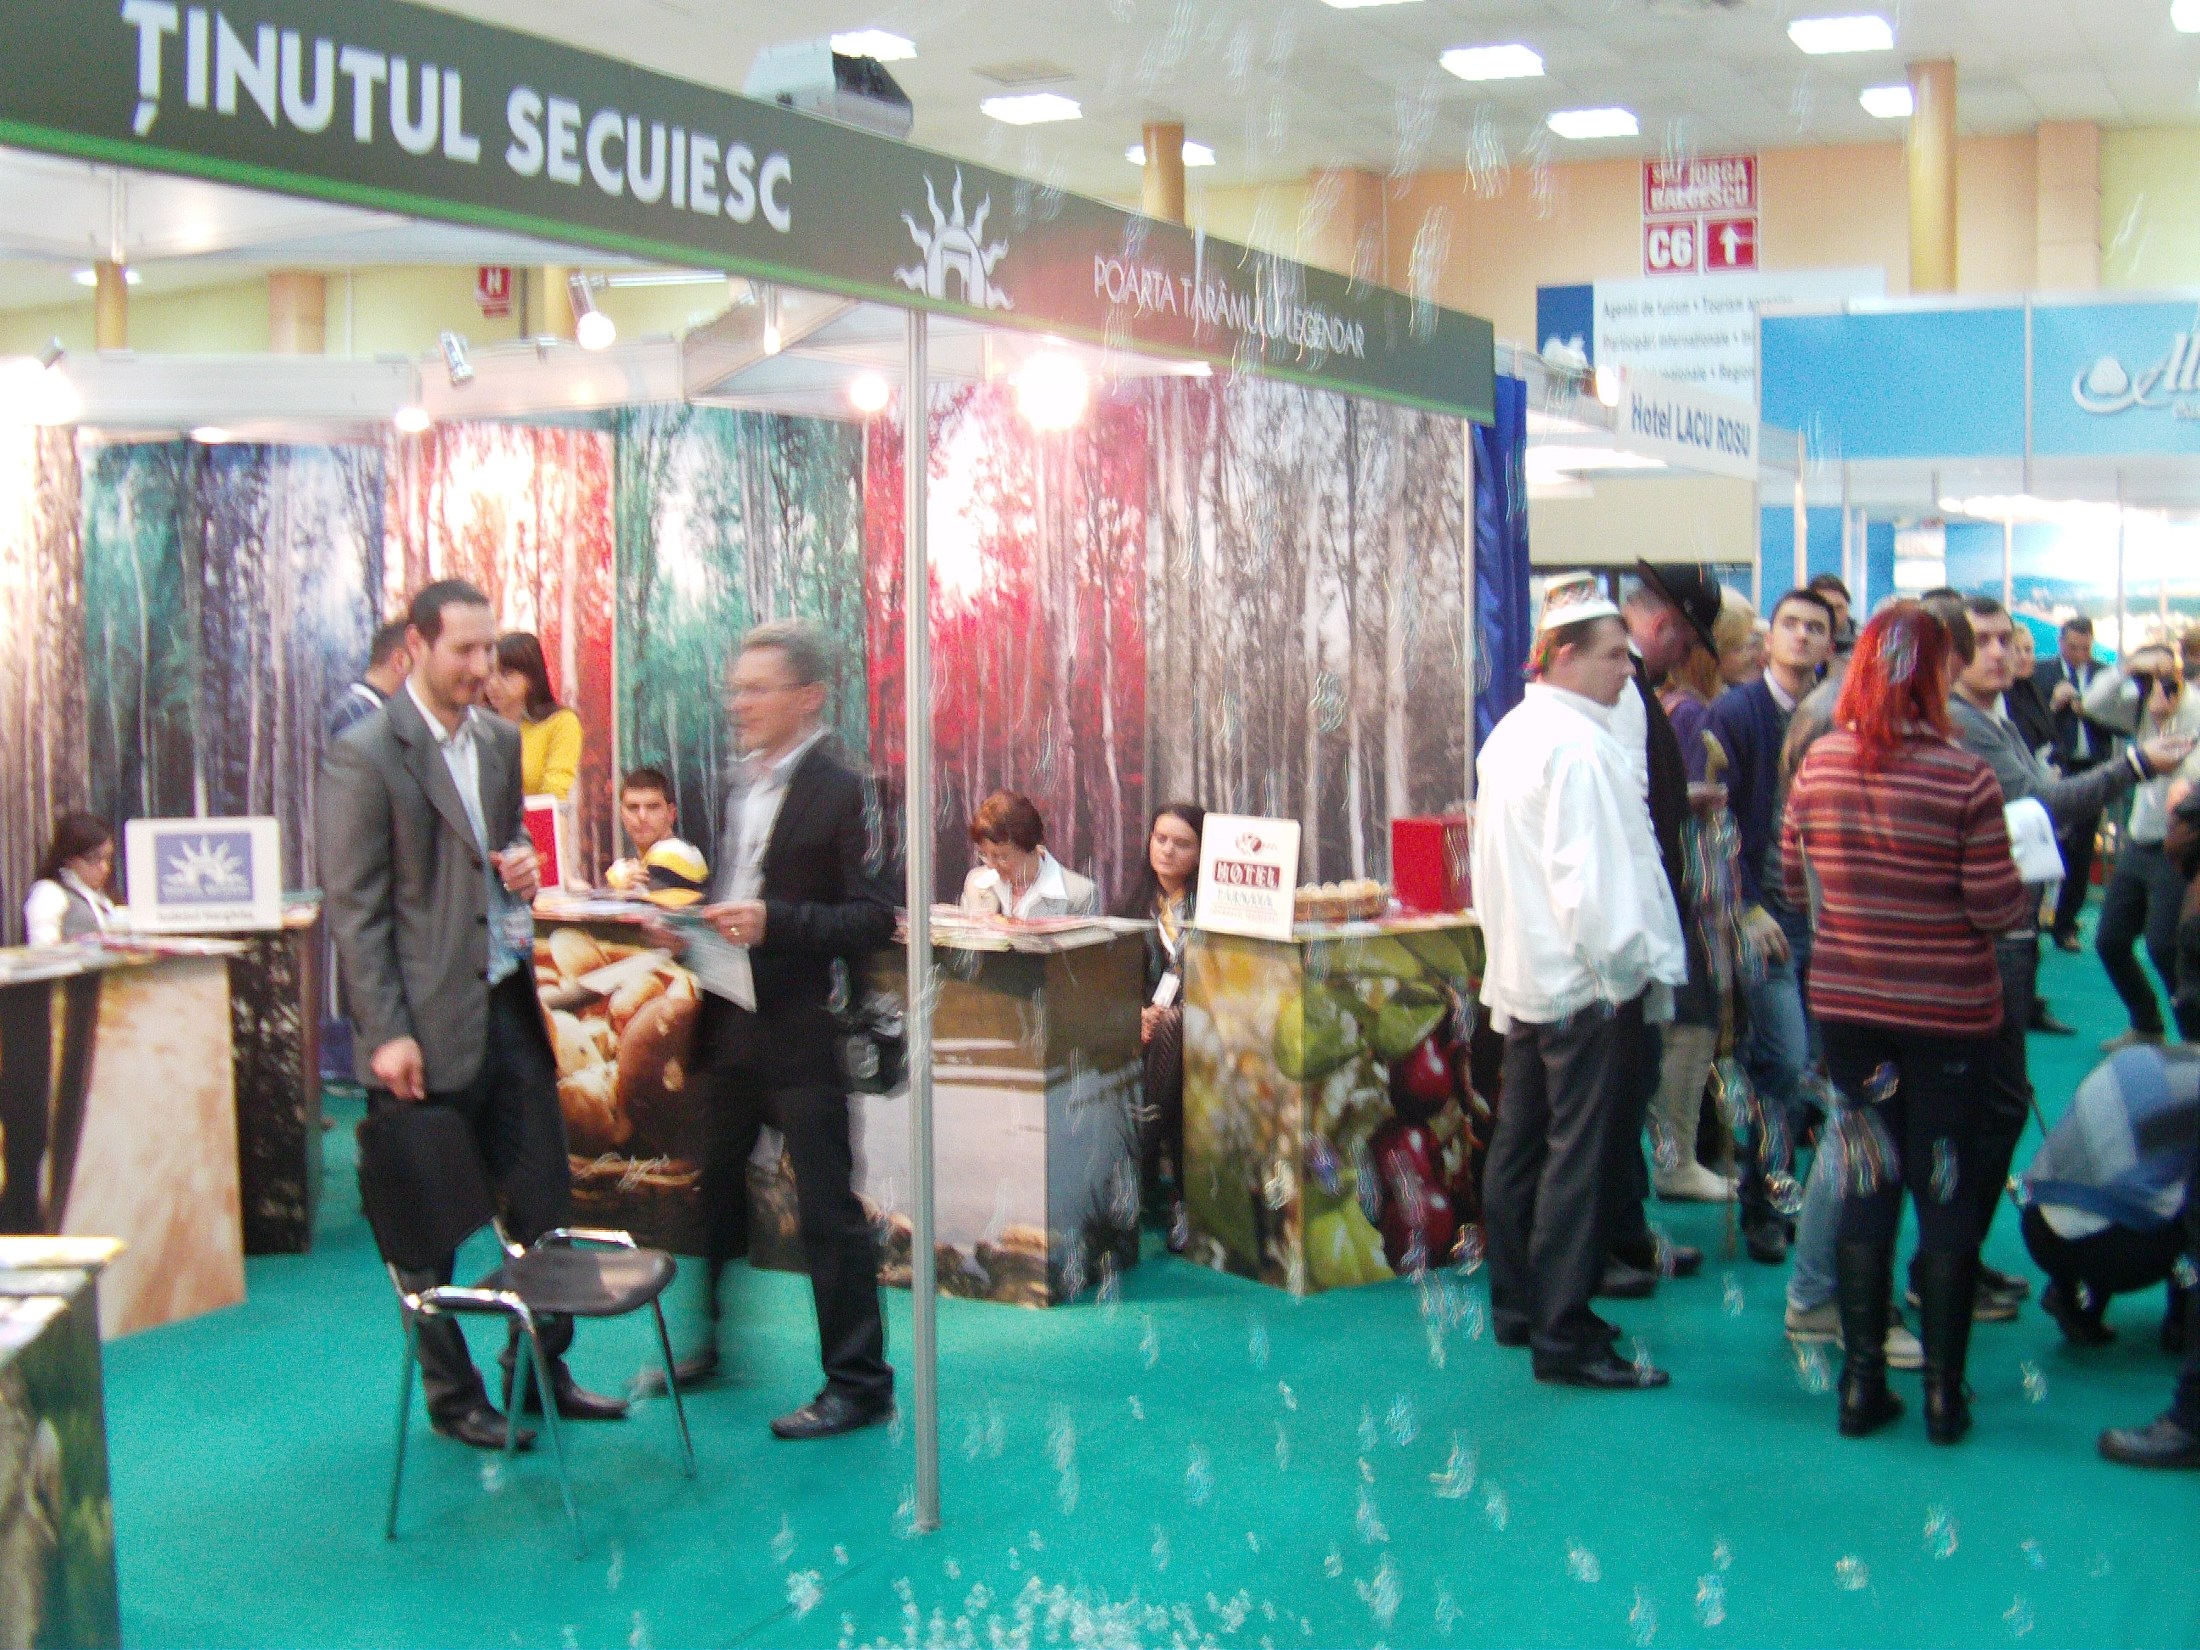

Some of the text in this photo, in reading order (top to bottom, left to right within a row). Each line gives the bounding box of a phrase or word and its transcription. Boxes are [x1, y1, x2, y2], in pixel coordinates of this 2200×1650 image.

[505, 86, 792, 233] SECUIESC
[1648, 228, 1693, 268] C6
[1094, 254, 1177, 316] POARTA
[1631, 391, 1672, 441] Hotel
[1676, 402, 1713, 450] LACU
[1216, 861, 1277, 889] HOTEL
